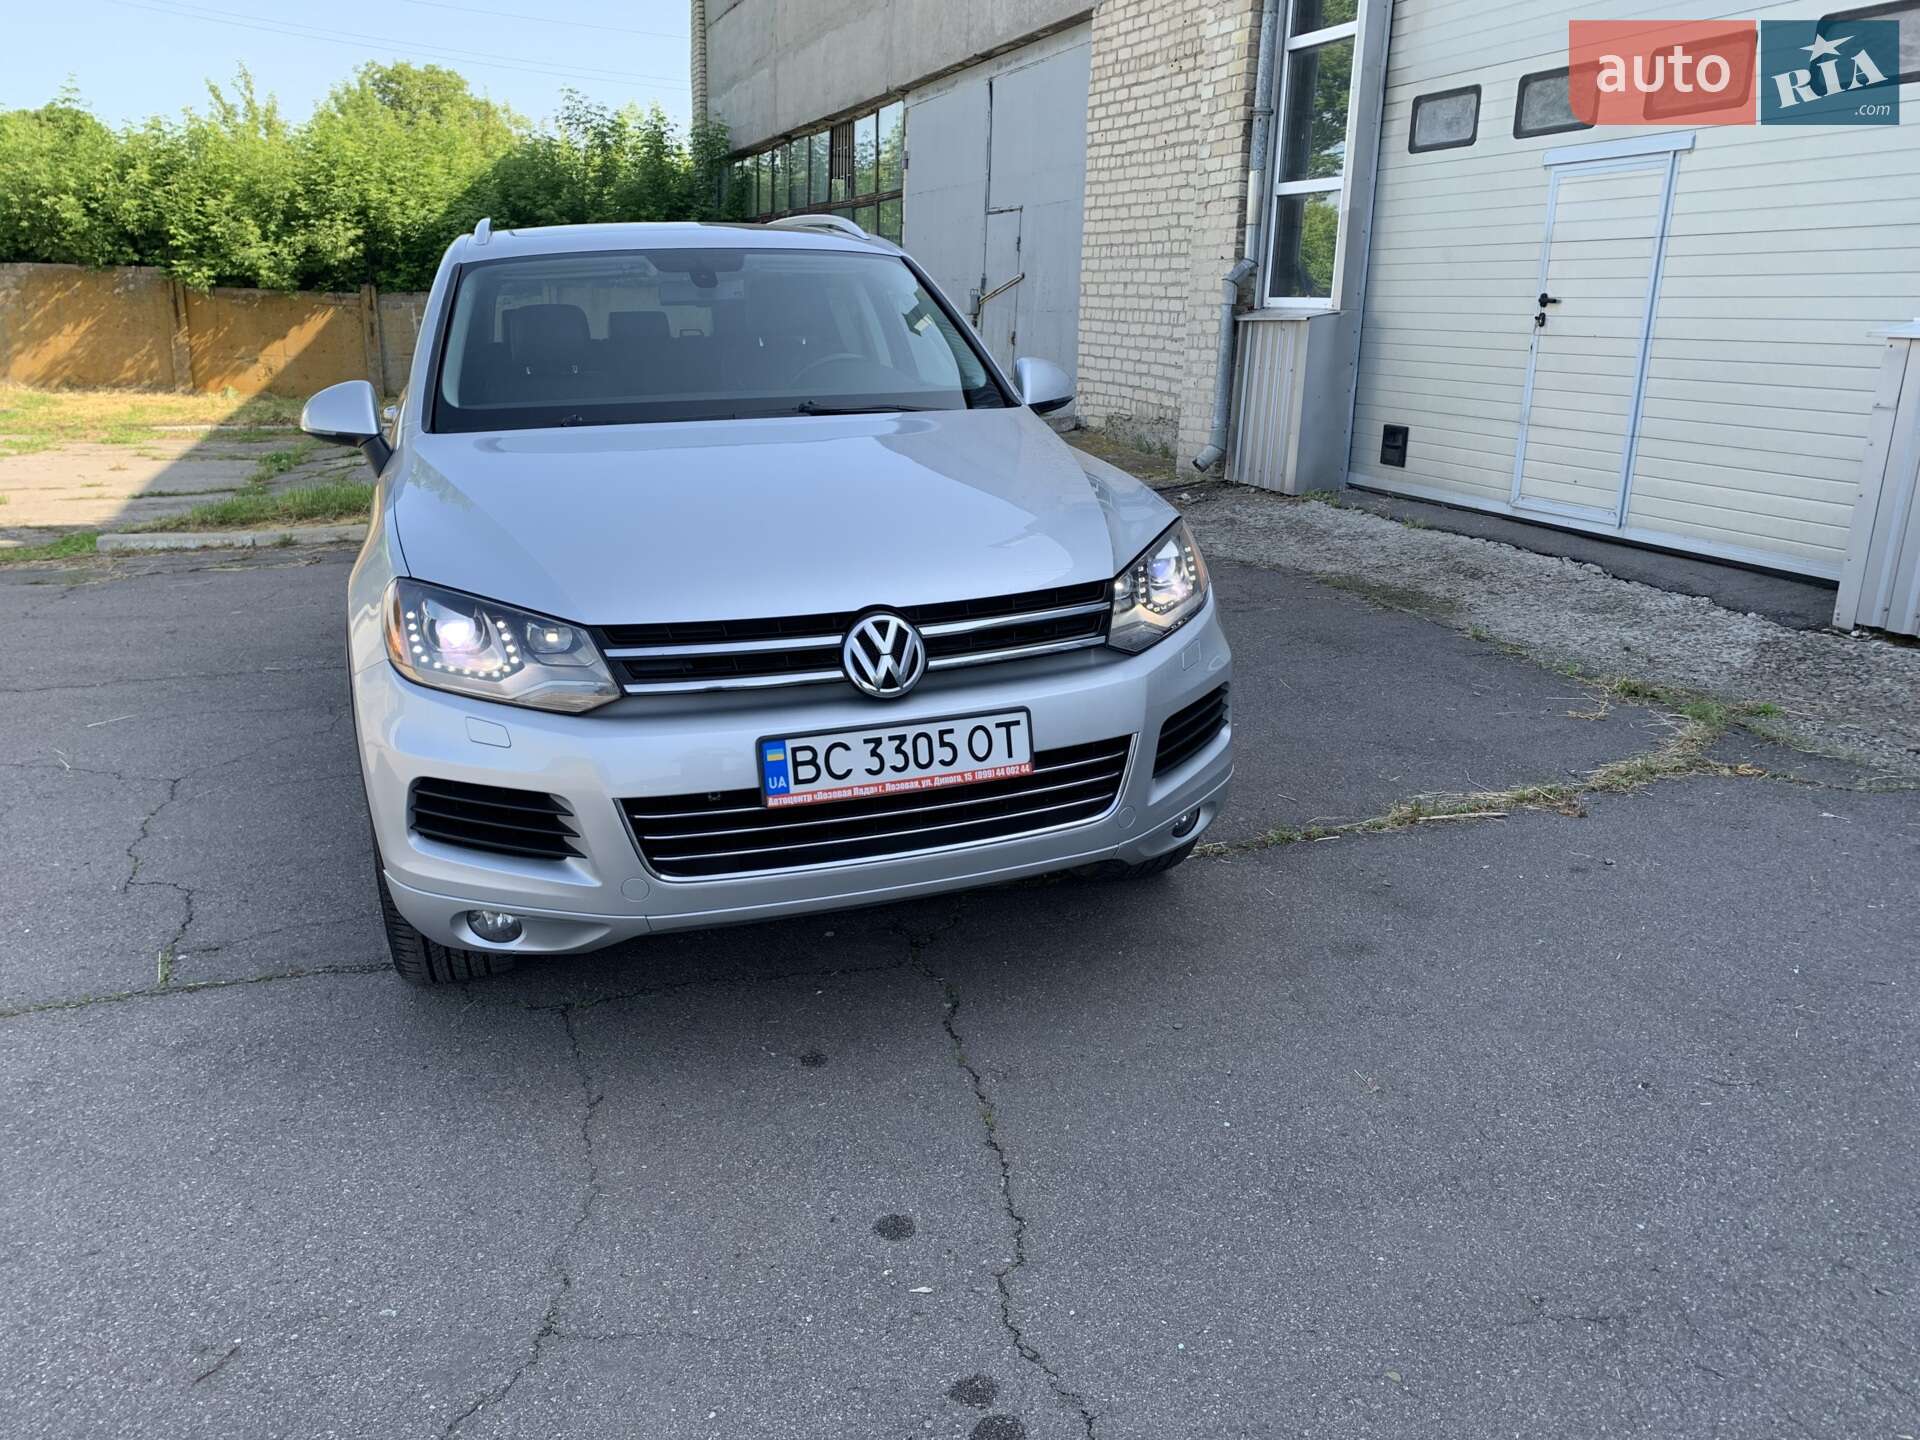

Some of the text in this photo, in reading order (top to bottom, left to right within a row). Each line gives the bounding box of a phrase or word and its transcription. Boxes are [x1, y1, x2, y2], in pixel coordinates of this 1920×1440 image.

[791, 720, 1021, 785] BC 3305 OT
[768, 777, 787, 789] UA
[768, 795, 812, 806] Автоцентр
[963, 772, 973, 782] 15
[996, 767, 1005, 776] 44
[1020, 763, 1030, 773] 44
